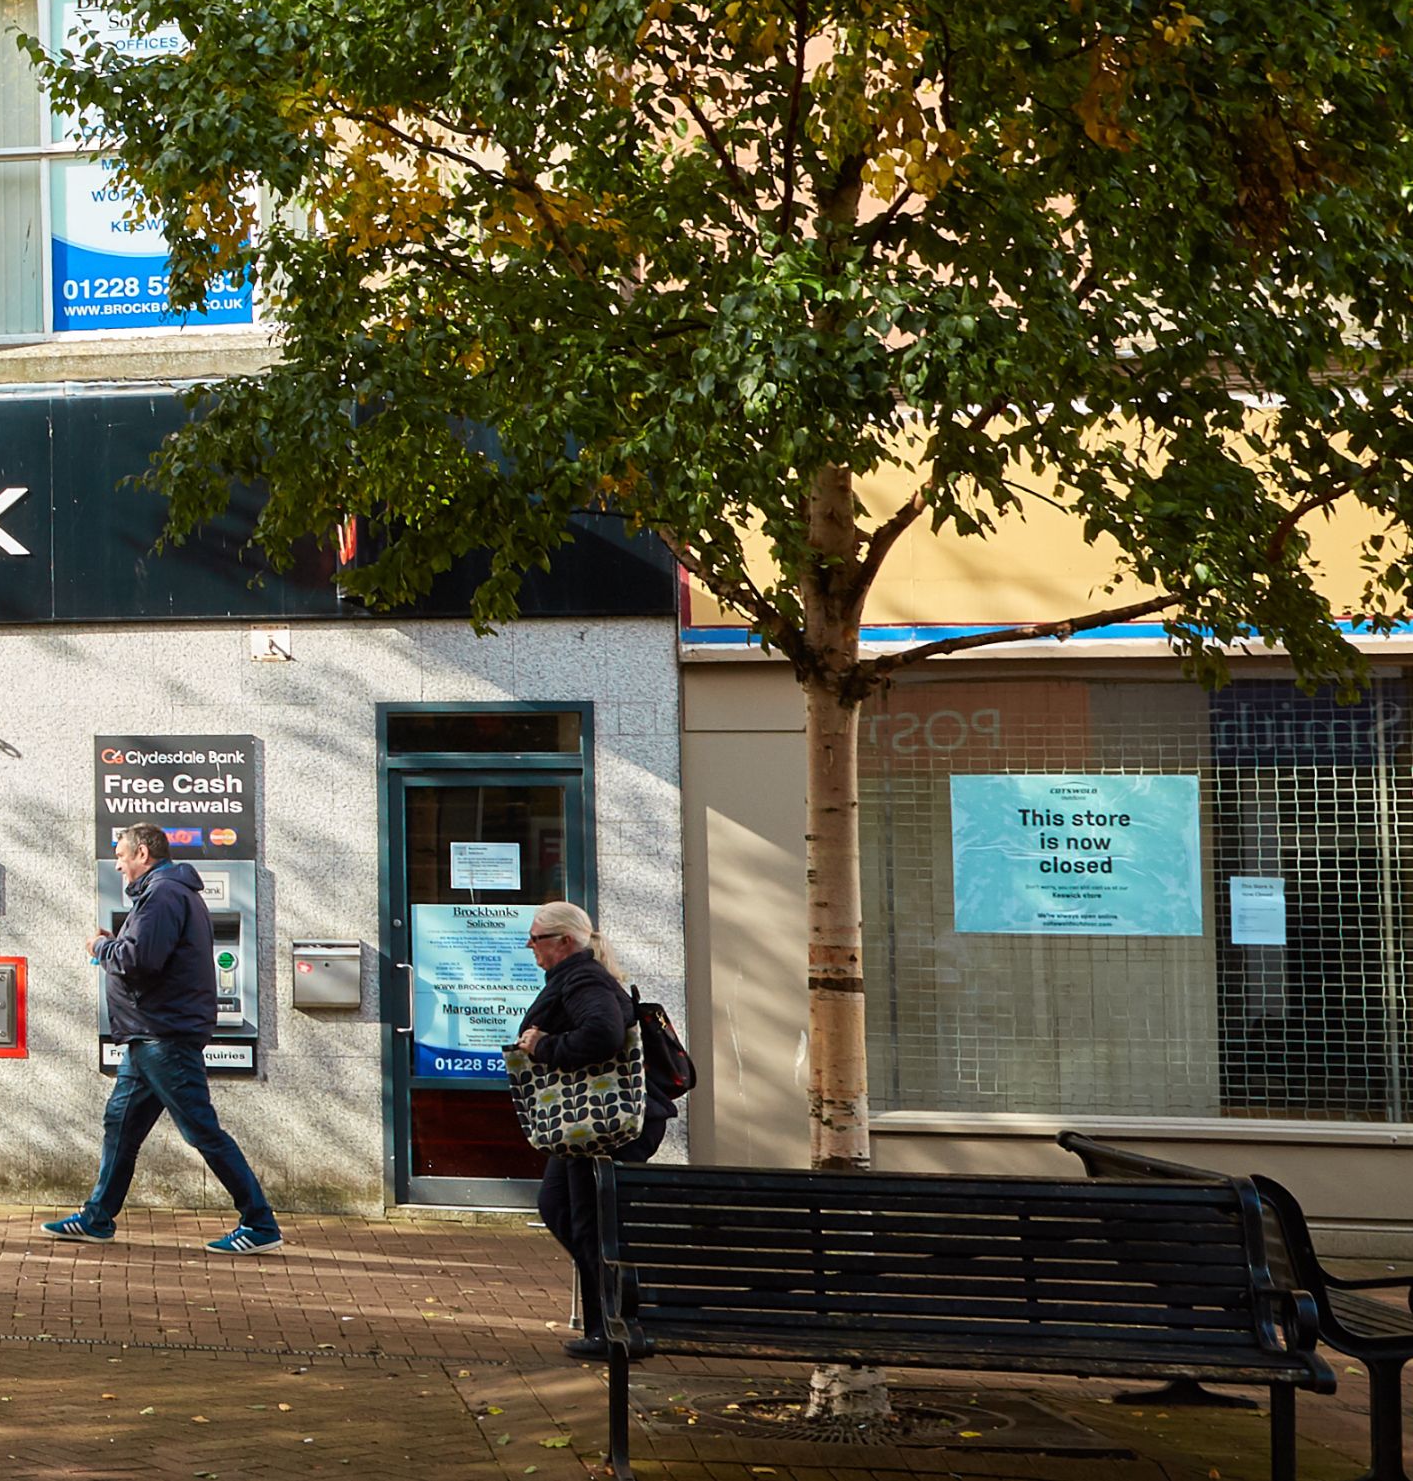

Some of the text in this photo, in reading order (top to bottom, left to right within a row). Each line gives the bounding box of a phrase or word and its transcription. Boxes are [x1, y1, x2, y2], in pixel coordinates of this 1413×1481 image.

[115, 37, 179, 51] OFFICES
[63, 276, 140, 300] 01228
[125, 750, 206, 767] Clydesdale
[208, 750, 245, 765] Bank
[104, 774, 243, 794] Free Cash
[104, 797, 244, 814] Withdrawals
[1018, 808, 1132, 827] This store
[1039, 832, 1112, 851] is now
[1039, 856, 1113, 874] closed
[203, 886, 222, 895] ank
[453, 906, 520, 920] Brockbanks
[466, 919, 507, 930] Solicitors
[471, 955, 502, 963] OFFICES
[434, 984, 542, 992] WWW.BROCKBANKS.CO.UK
[442, 1004, 529, 1017] Margaret Payn
[469, 1016, 508, 1026] Solicitor
[434, 1057, 483, 1072] 01228
